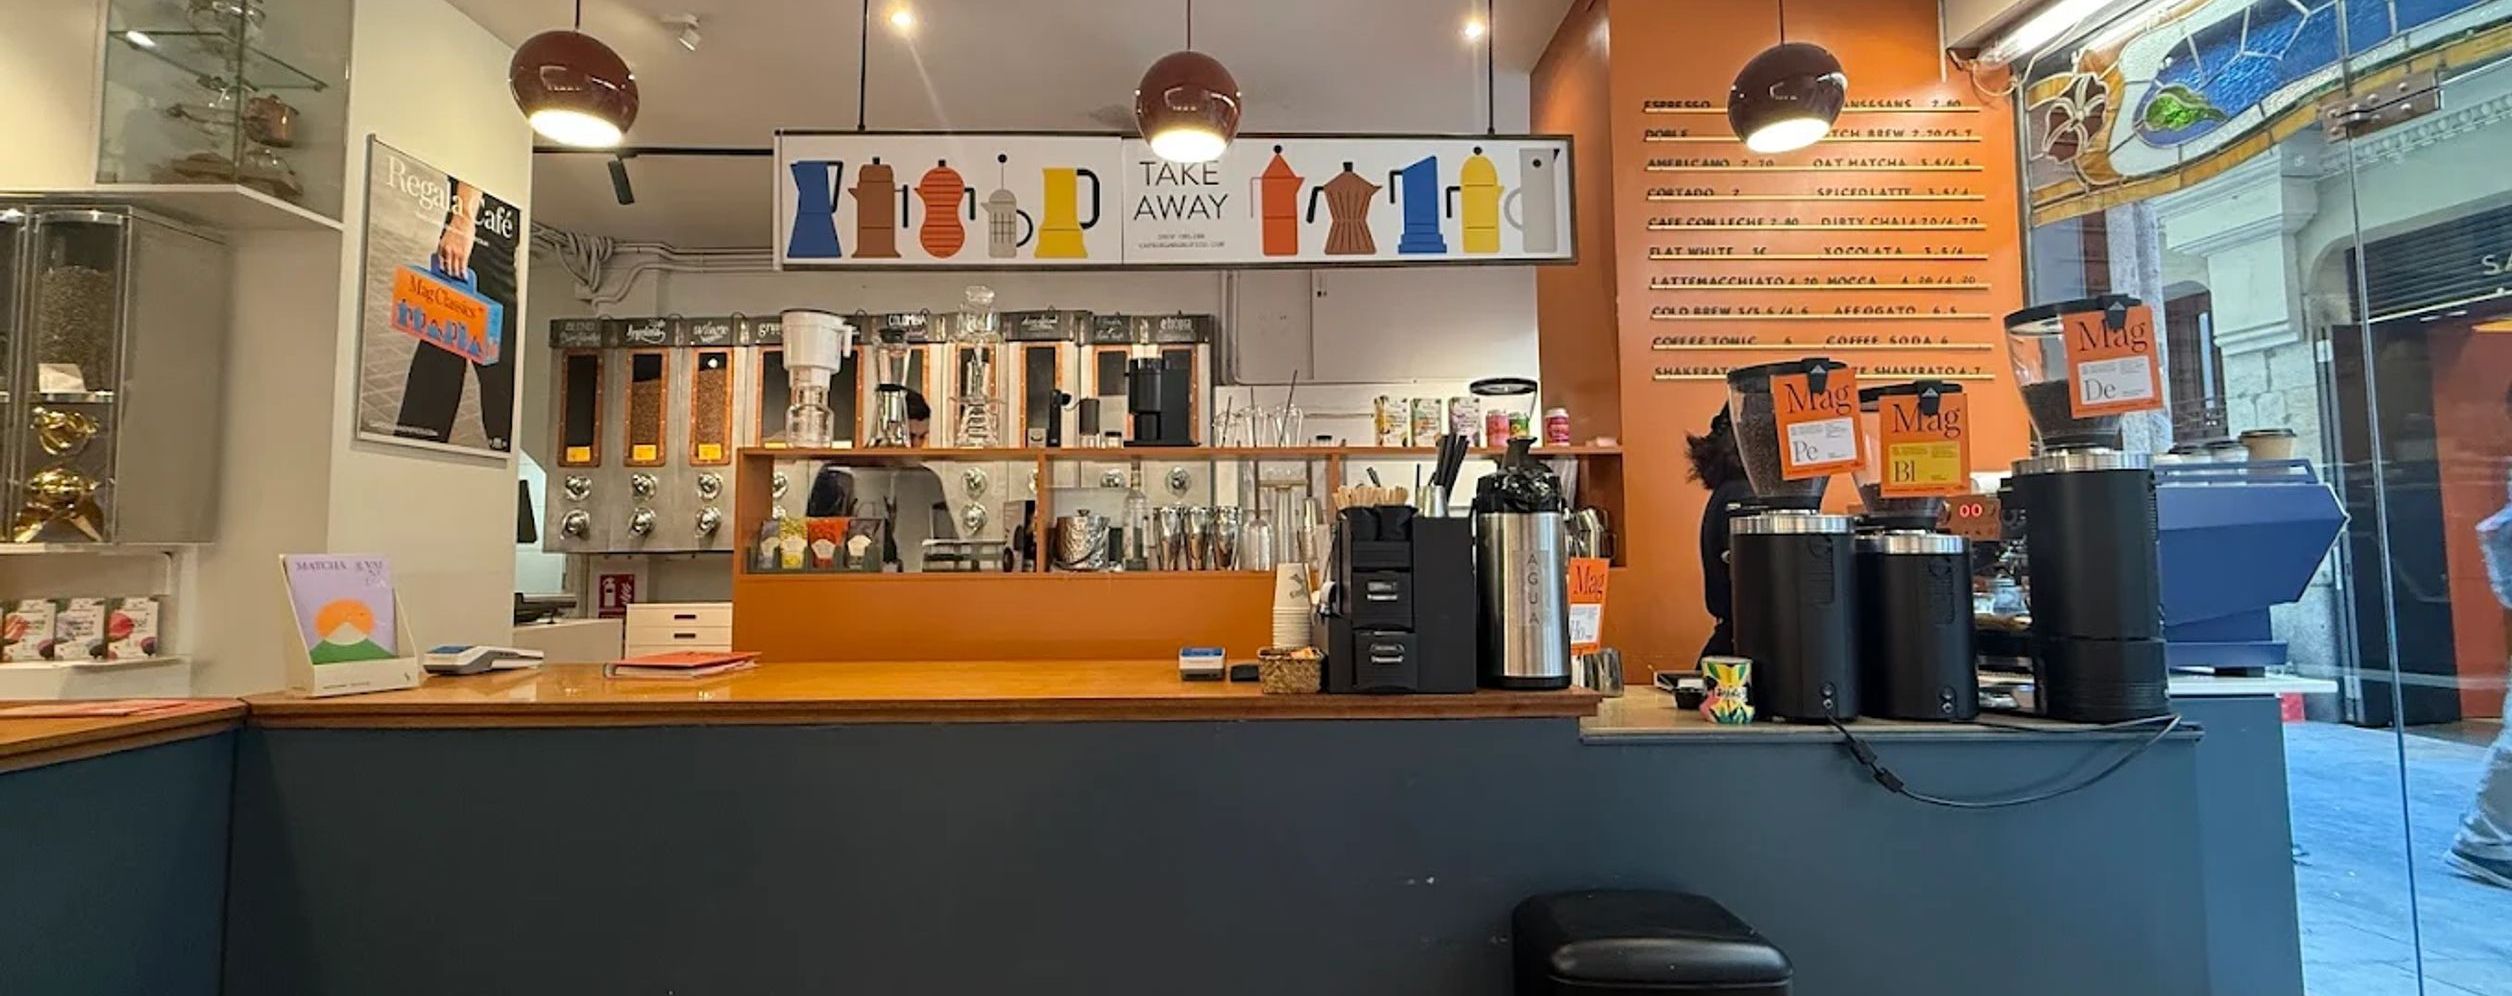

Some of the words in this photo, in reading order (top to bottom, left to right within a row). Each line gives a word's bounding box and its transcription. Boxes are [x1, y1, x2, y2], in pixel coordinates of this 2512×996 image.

[1867, 129, 1904, 137] BREW
[1647, 159, 1730, 167] AMERICANO
[1813, 159, 1843, 167] OAT
[1849, 159, 1905, 167] MATCHA
[1139, 160, 1219, 186] TAKE
[1648, 188, 1714, 196] CORTADO
[388, 156, 464, 216] Regala
[470, 197, 513, 239] Café
[1133, 194, 1229, 220] AWAY
[1821, 218, 1864, 226] DIRTY
[1650, 247, 1682, 255] FLAT
[1688, 247, 1734, 255] WHITE
[1823, 246, 1902, 255] XOCOLATA
[1826, 276, 1877, 284] MOCCA
[1693, 306, 1731, 315] BREW
[1652, 336, 1705, 345] COFFEE
[1710, 336, 1758, 345] TONIC
[1826, 336, 1879, 345] COFFEE
[1889, 336, 1932, 345] SODA
[2076, 318, 2148, 354] Mag
[1875, 366, 1955, 375] SHAKERATO
[2084, 378, 2116, 401] De
[1785, 382, 1851, 416] Mag
[1893, 402, 1962, 439] Mag
[1959, 503, 1983, 518] 00
[1527, 553, 1540, 625] AGUA
